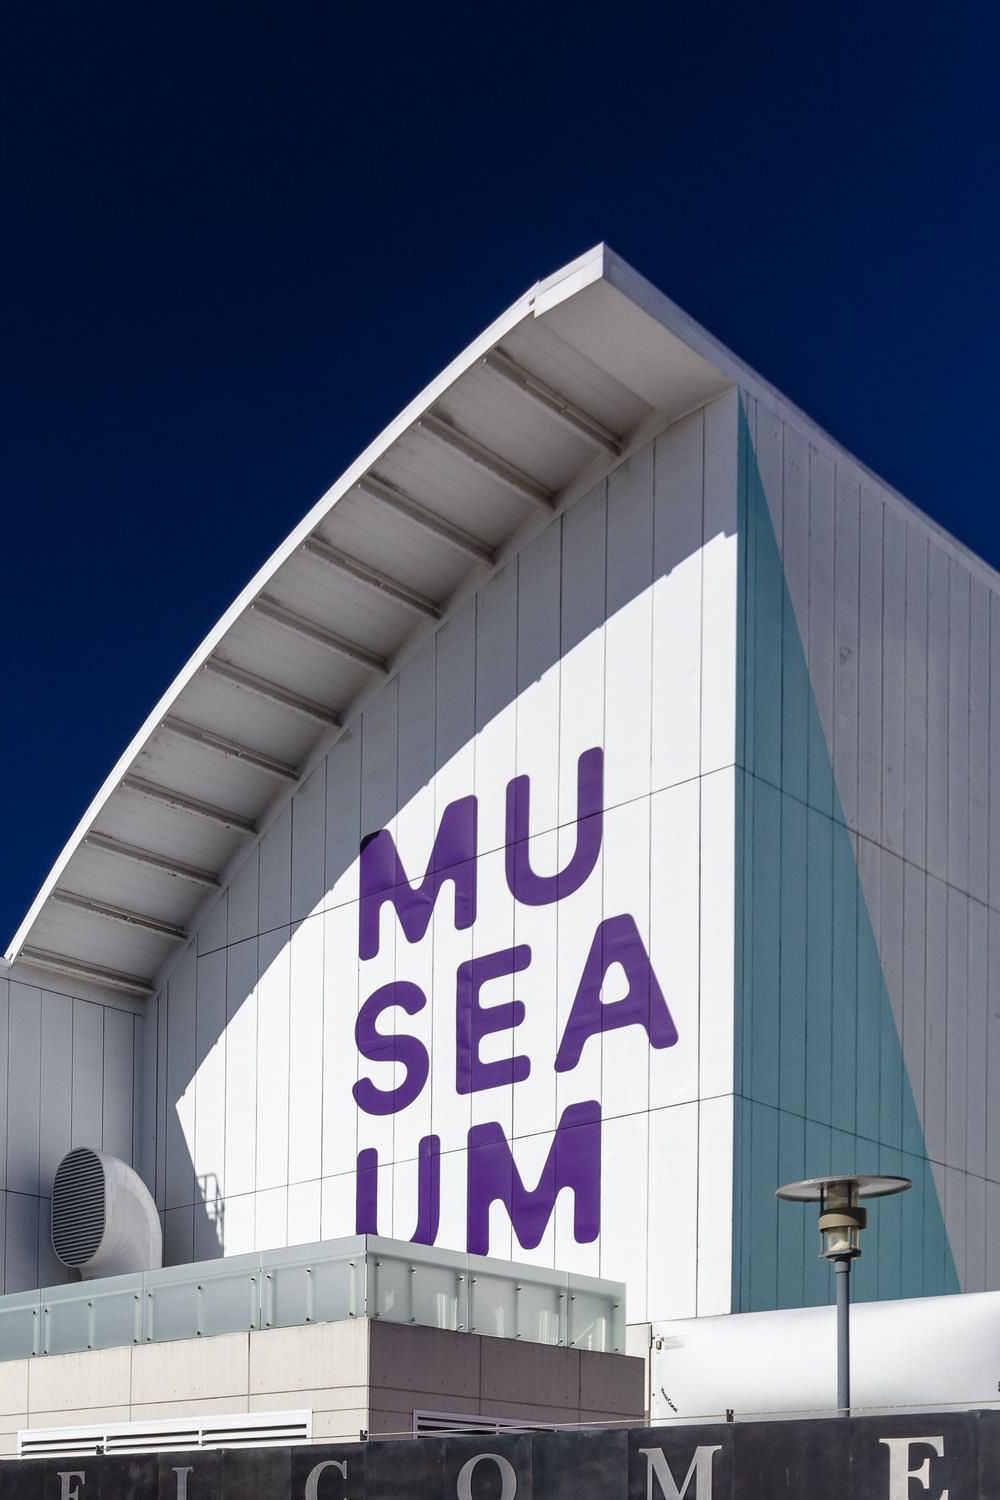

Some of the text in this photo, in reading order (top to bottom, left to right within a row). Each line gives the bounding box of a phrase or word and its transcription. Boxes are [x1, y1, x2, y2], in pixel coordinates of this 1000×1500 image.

[359, 746, 604, 961] MU
[352, 913, 679, 1116] SEA
[356, 1099, 601, 1257] UM
